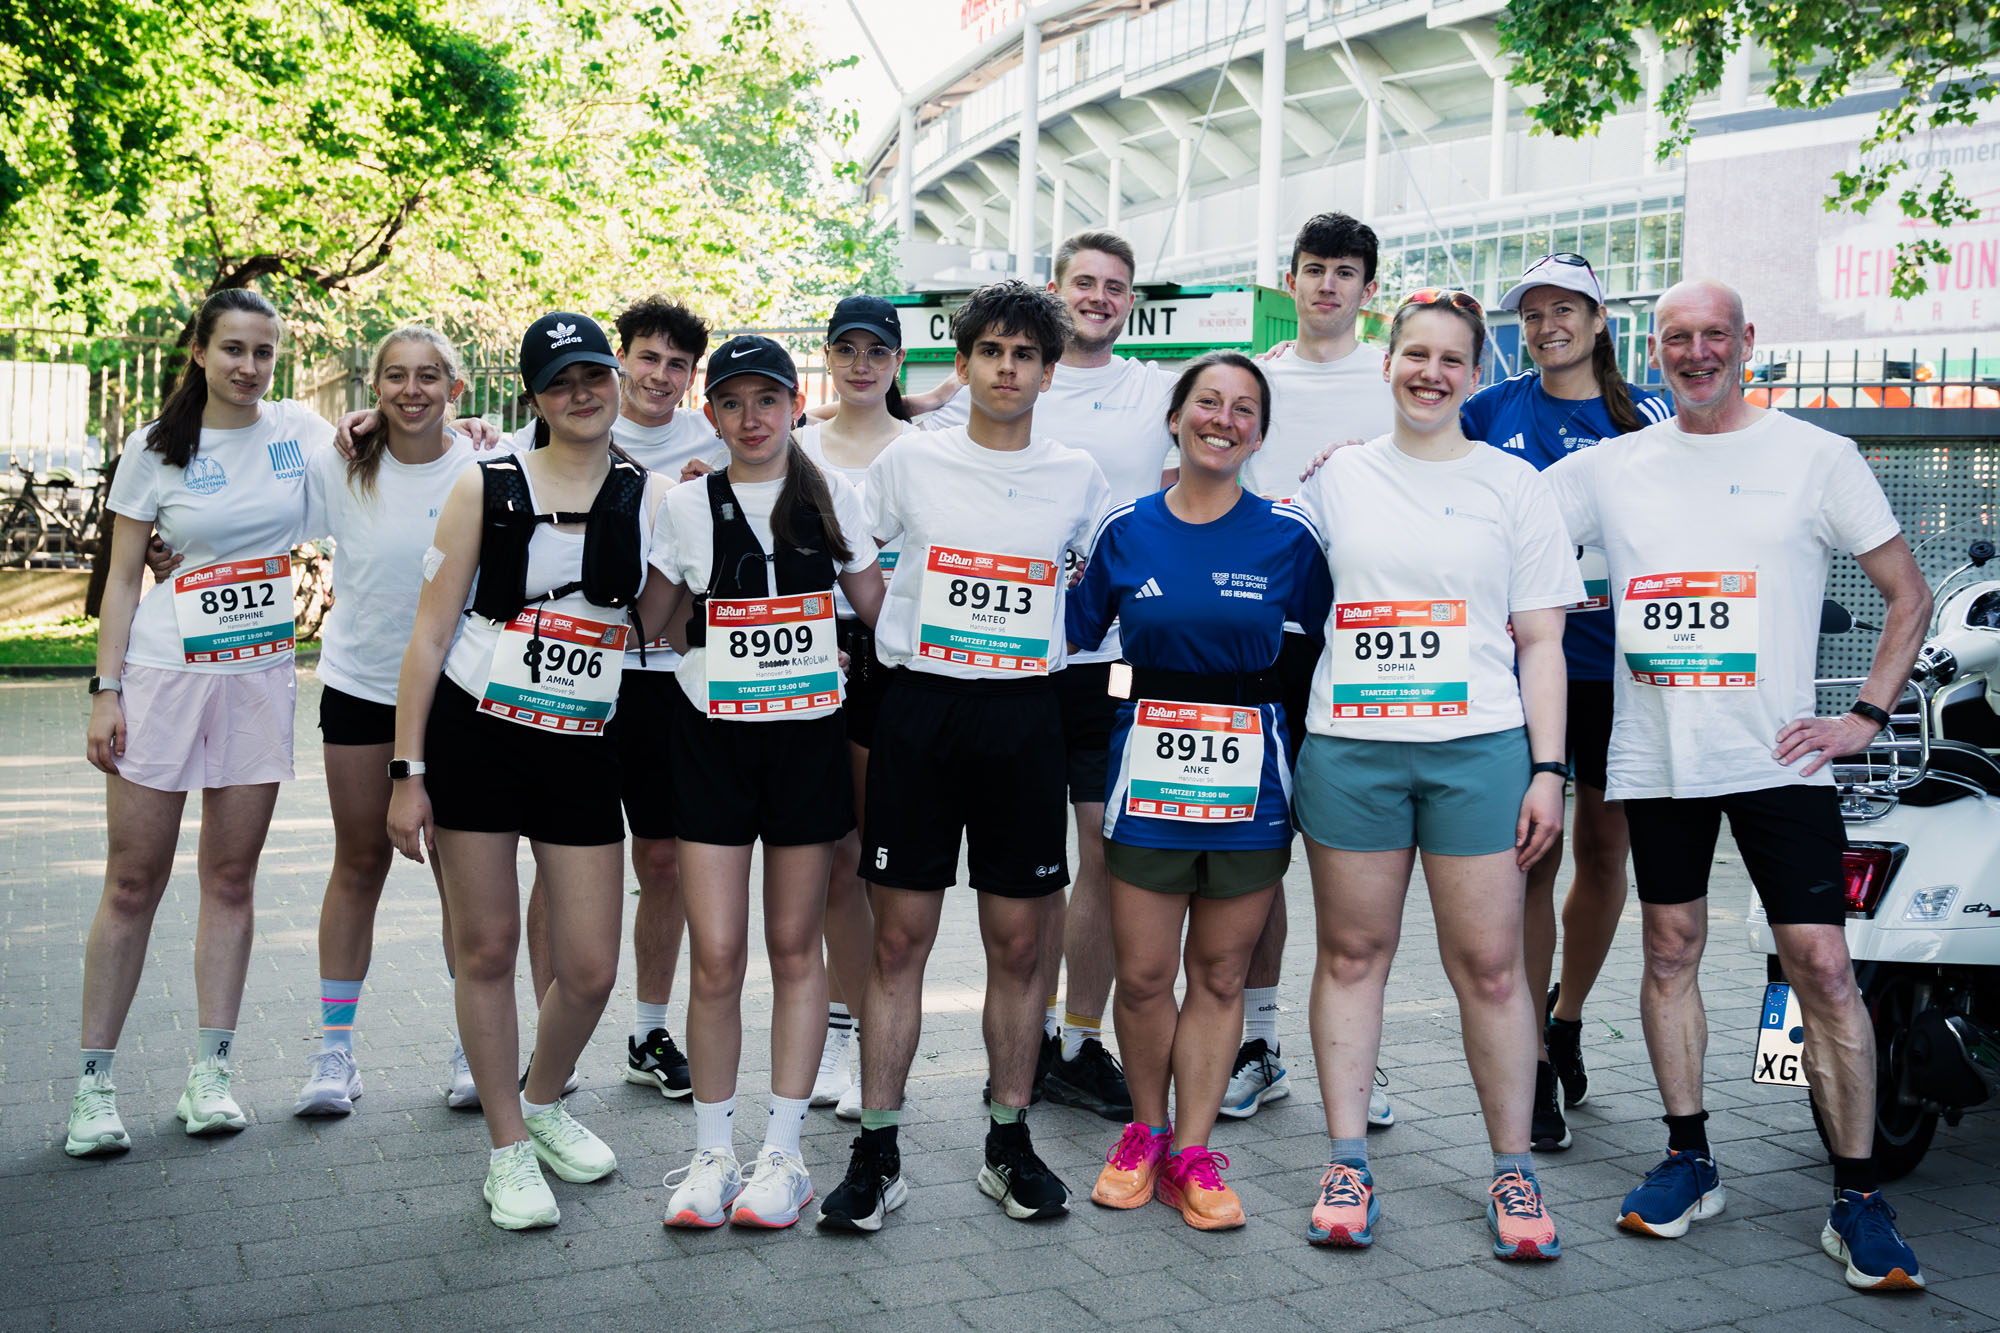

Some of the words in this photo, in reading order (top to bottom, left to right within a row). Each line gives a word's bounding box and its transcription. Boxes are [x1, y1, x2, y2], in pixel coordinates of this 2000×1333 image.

[1128, 308, 1177, 336] INT
[551, 336, 582, 349] adidas
[1232, 573, 1268, 583] ELITESCHULE
[1245, 582, 1266, 590] SPORTS
[200, 583, 275, 614] 8912
[948, 579, 1032, 614] 8913
[219, 611, 264, 625] JOSEPHINE
[972, 613, 1006, 624] MATEO
[1644, 602, 1730, 630] 8918
[970, 624, 998, 632] Hannover
[212, 636, 246, 644] STARTZEIT
[248, 632, 263, 640] 19:00
[730, 626, 812, 658] 8909
[950, 634, 988, 646] STARTZEIT
[988, 640, 1008, 648] 19:00
[1674, 634, 1696, 642] UWE
[1355, 630, 1440, 660] 8919
[523, 640, 603, 678] 8906
[1649, 658, 1685, 666] STARTZEIT
[1687, 658, 1708, 666] 19:00
[1709, 658, 1723, 666] Uhr
[756, 670, 783, 678] Hannover
[1378, 664, 1416, 672] SOPHIA
[546, 675, 574, 687] AMNA
[540, 685, 568, 694] Hannover
[738, 685, 776, 694] STARTZEIT
[1360, 689, 1398, 697] STARTZEIT
[1422, 688, 1436, 696] Uhr
[518, 694, 555, 708] STARTZEIT
[557, 701, 576, 710] 19:00
[576, 704, 587, 712] Uhr
[1156, 732, 1240, 764] 8916
[1184, 766, 1210, 774] ANKE
[1160, 788, 1196, 797] STARTZEIT
[876, 846, 888, 870] 5
[1768, 1012, 1779, 1024] D
[1758, 1052, 1798, 1082] XG
